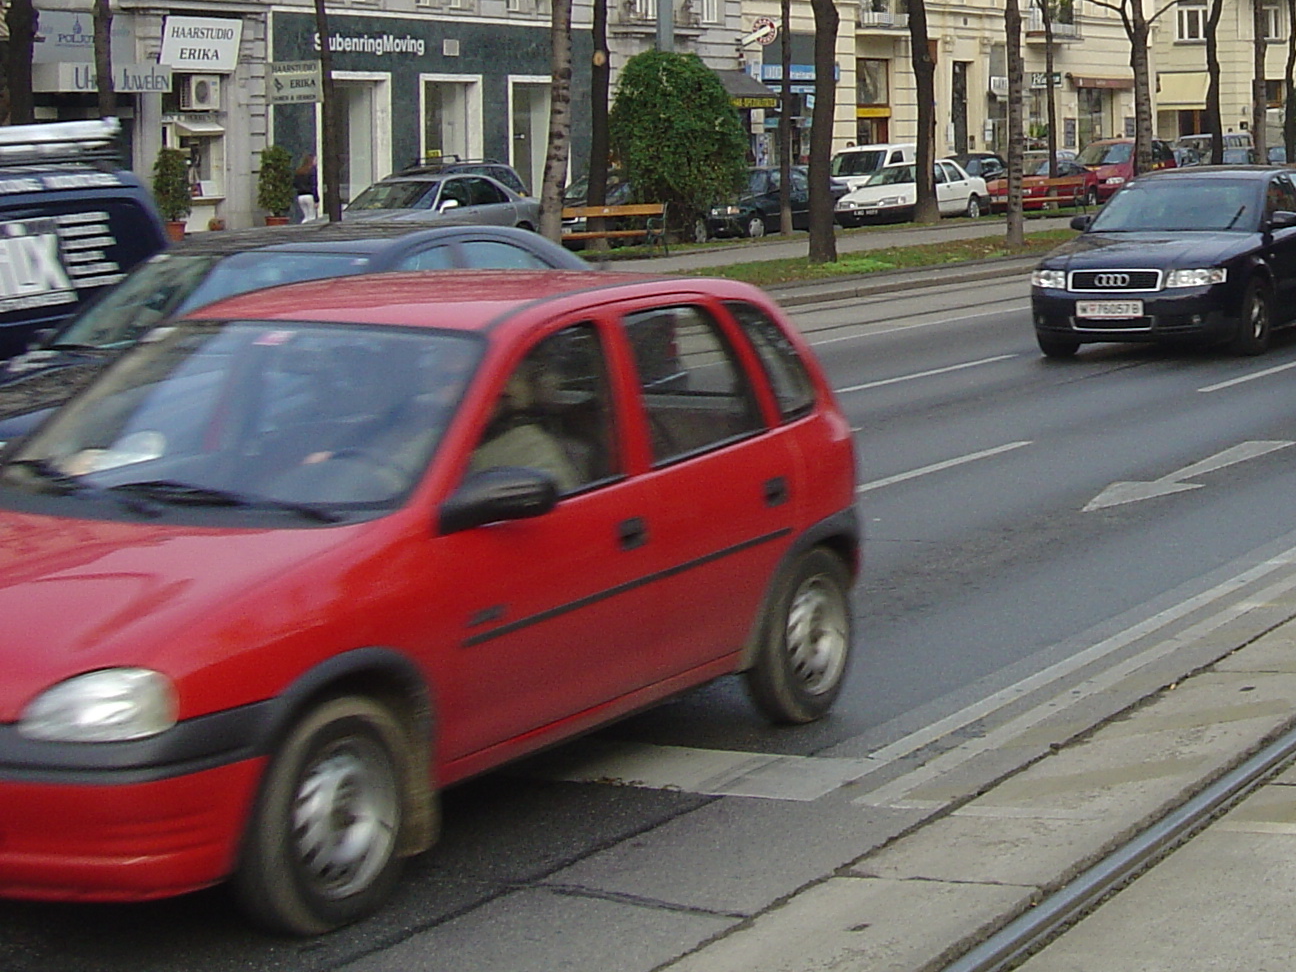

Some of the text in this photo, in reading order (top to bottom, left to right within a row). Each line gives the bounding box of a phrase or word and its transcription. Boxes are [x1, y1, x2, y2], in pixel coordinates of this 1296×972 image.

[171, 26, 234, 41] HAARSTUDIO
[314, 32, 425, 55] SubenringMoving
[179, 47, 220, 61] ERIKA
[290, 79, 317, 89] ERIKA
